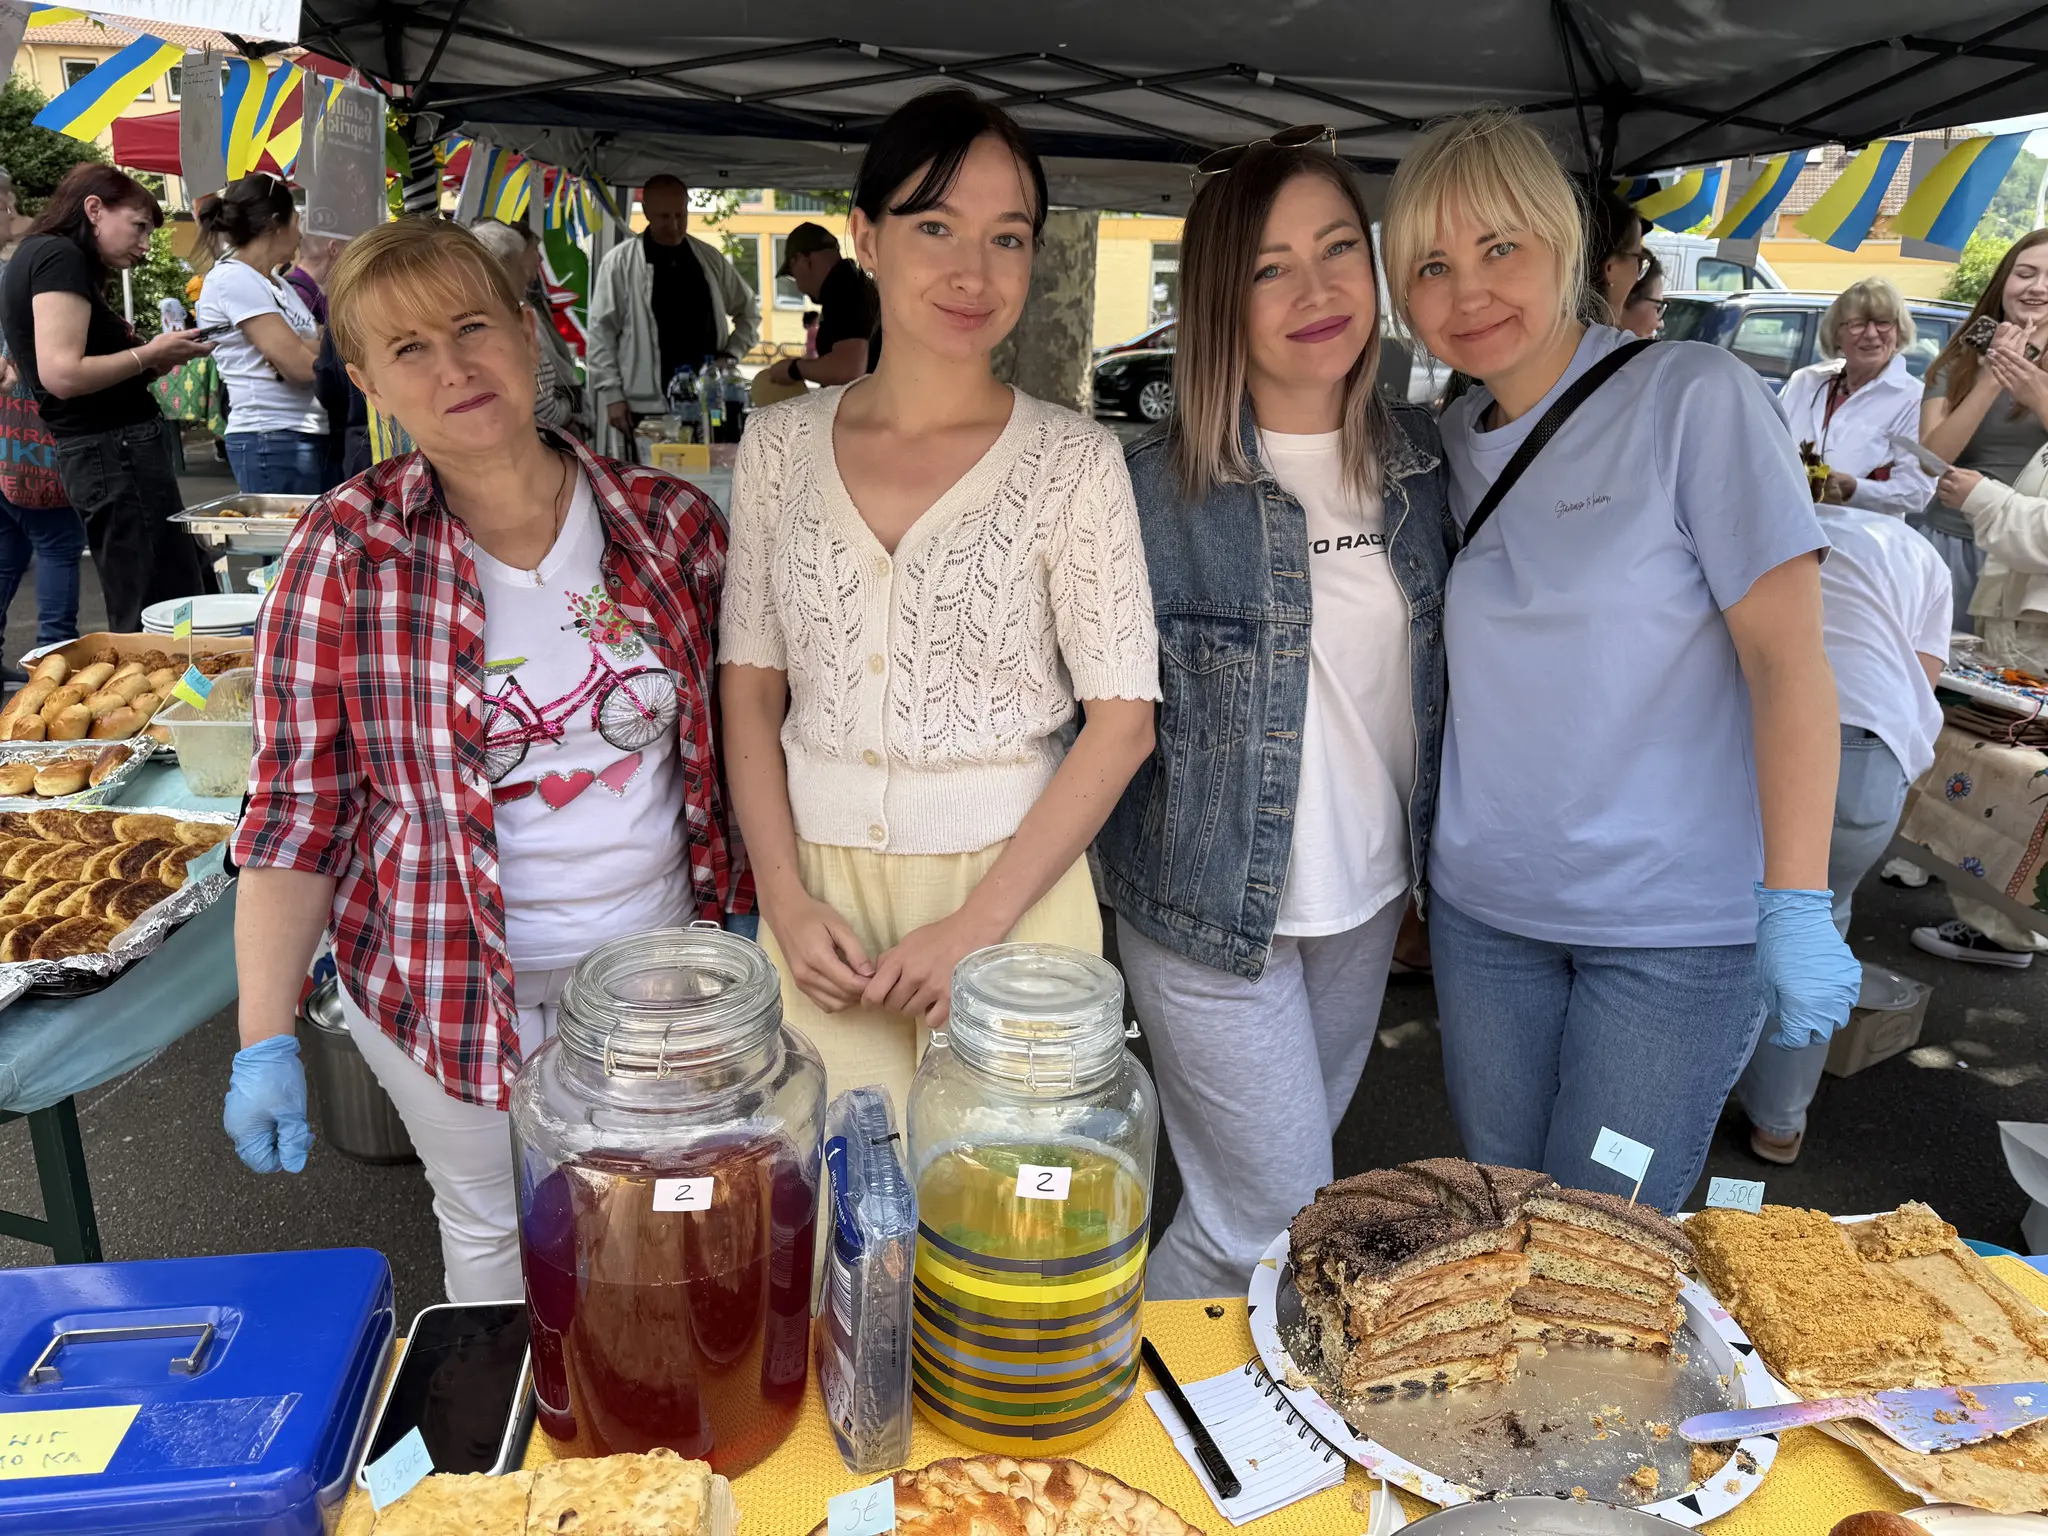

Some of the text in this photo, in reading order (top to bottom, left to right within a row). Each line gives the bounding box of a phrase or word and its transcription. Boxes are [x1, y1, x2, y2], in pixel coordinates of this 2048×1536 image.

[1308, 539, 1330, 555] O
[1608, 1141, 1622, 1161] 4
[1036, 1172, 1055, 1192] 2
[674, 1184, 694, 1201] 2
[1709, 1182, 1759, 1206] 2,50€
[844, 1491, 881, 1532] 3€
